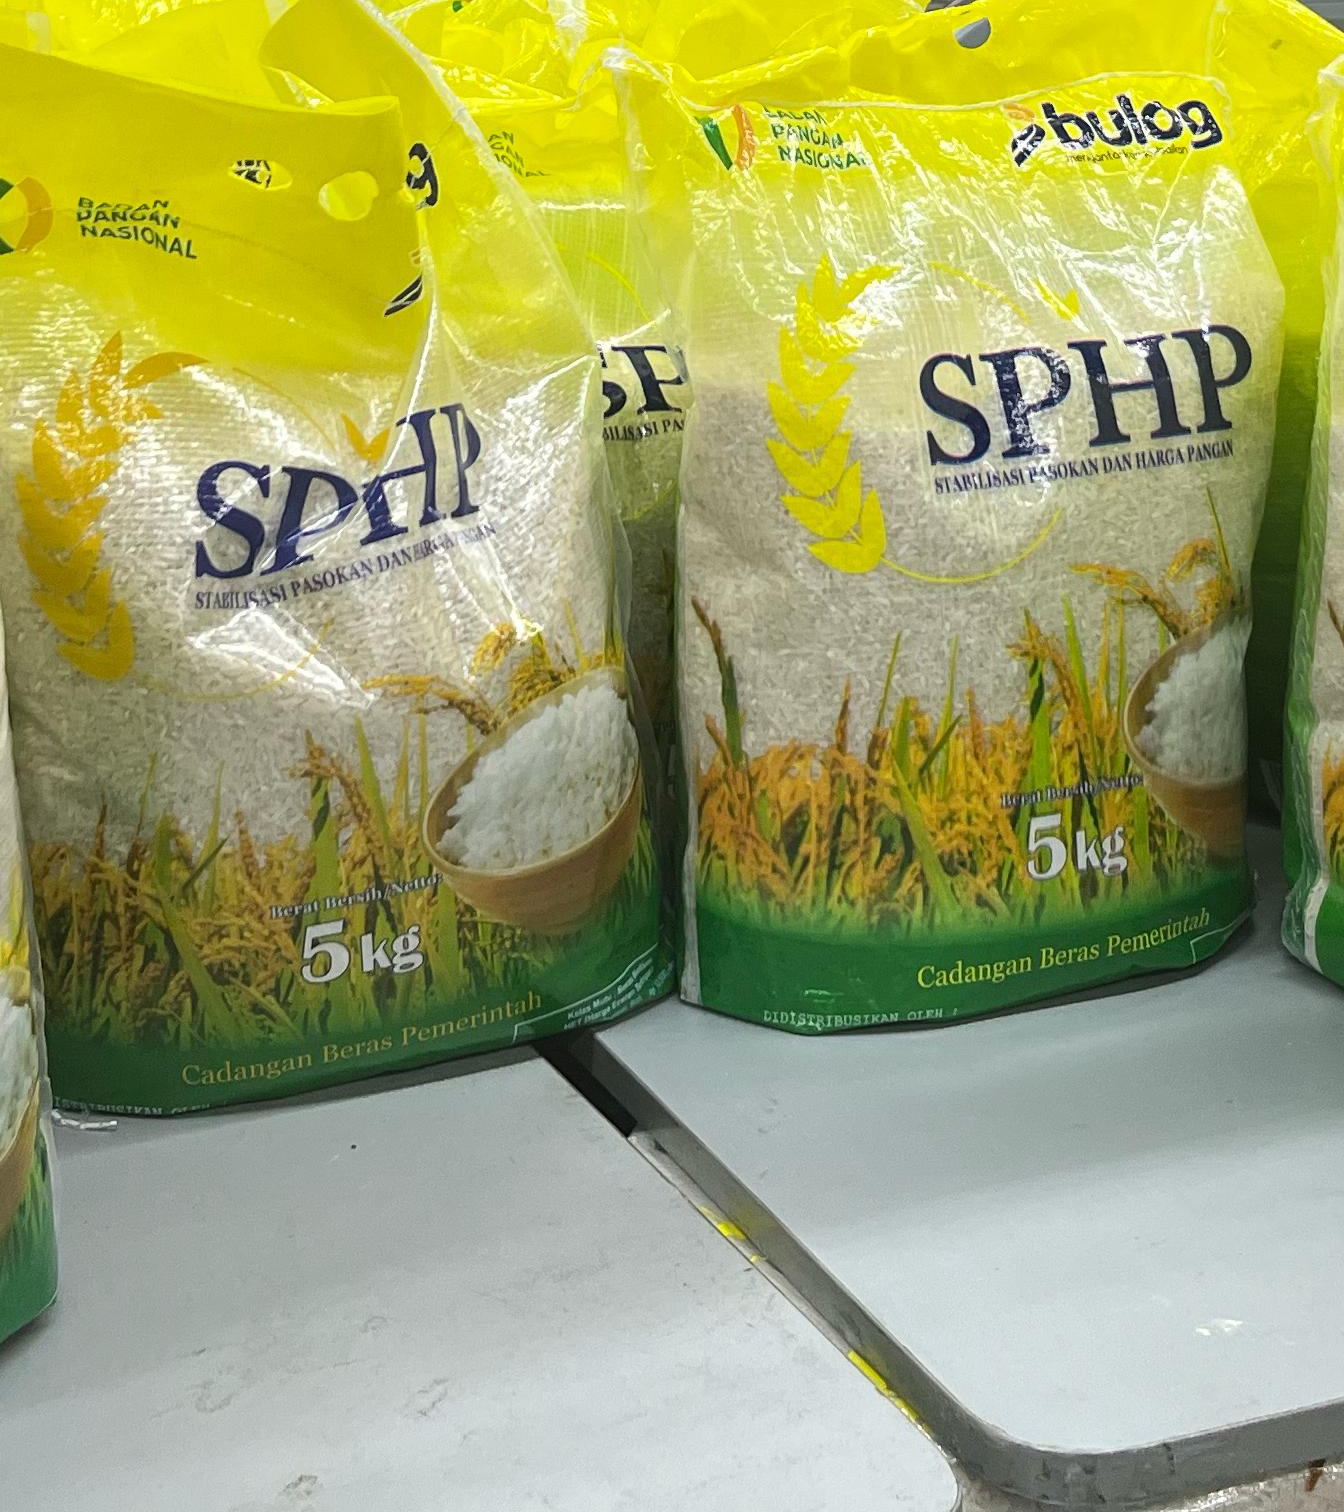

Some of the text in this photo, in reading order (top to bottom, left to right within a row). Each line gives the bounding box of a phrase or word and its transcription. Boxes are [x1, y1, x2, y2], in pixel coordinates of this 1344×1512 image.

[1041, 93, 1223, 150] bulog
[80, 225, 198, 260] NASIONAL
[918, 324, 1253, 465] SPHP
[194, 401, 482, 580] SPHP
[933, 438, 1235, 495] STABILISASI PASOKAN DAN HARGA PANGAN
[194, 585, 288, 609] STABILISASI
[290, 560, 374, 600] PASOKAN
[378, 546, 412, 576] DAN
[1026, 812, 1128, 881] 5 kg
[269, 899, 320, 921] Berat
[300, 919, 426, 984] 5 kg
[916, 907, 1211, 990] Cadangan Beras Pemerintah
[180, 990, 544, 1087] Cadangan Beras Pemerintah
[762, 1009, 900, 1031] DIDISTRIBUSIKAN
